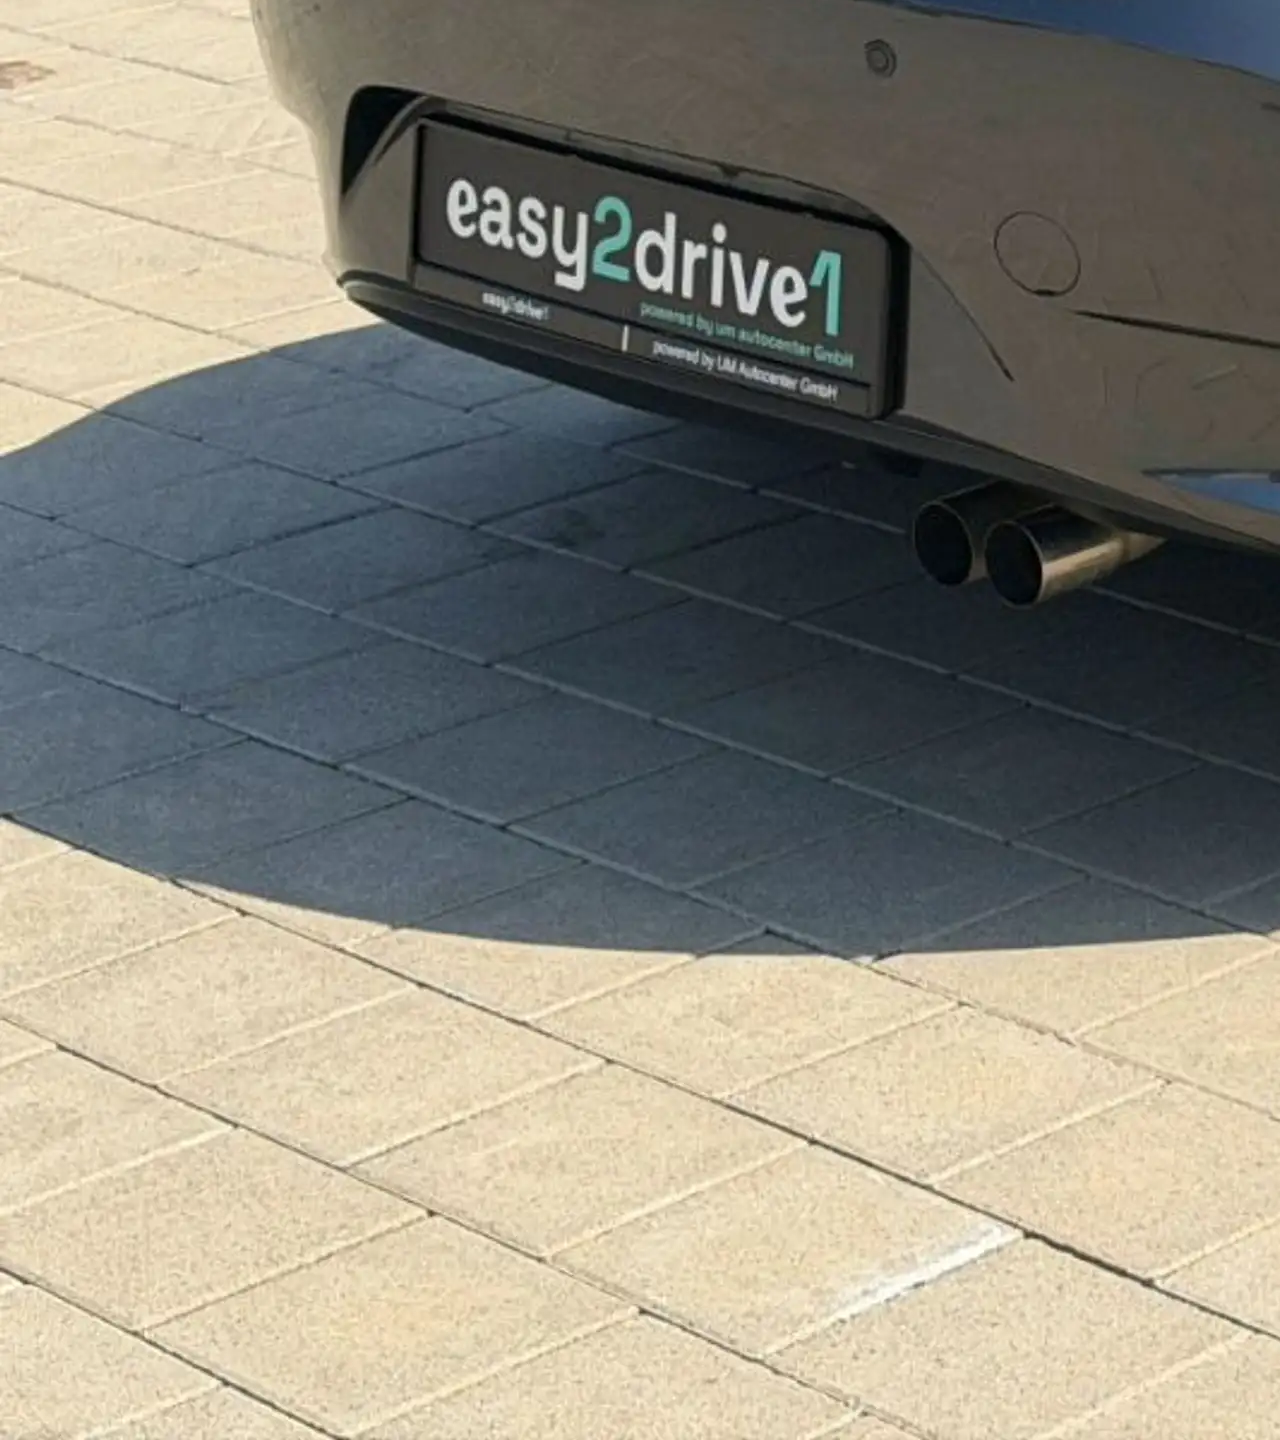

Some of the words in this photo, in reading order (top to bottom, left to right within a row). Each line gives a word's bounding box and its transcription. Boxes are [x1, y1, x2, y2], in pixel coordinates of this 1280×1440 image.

[447, 180, 842, 336] easy2drive1
[639, 300, 694, 328] powered
[652, 339, 700, 365] powered
[800, 376, 838, 403] GmbH
